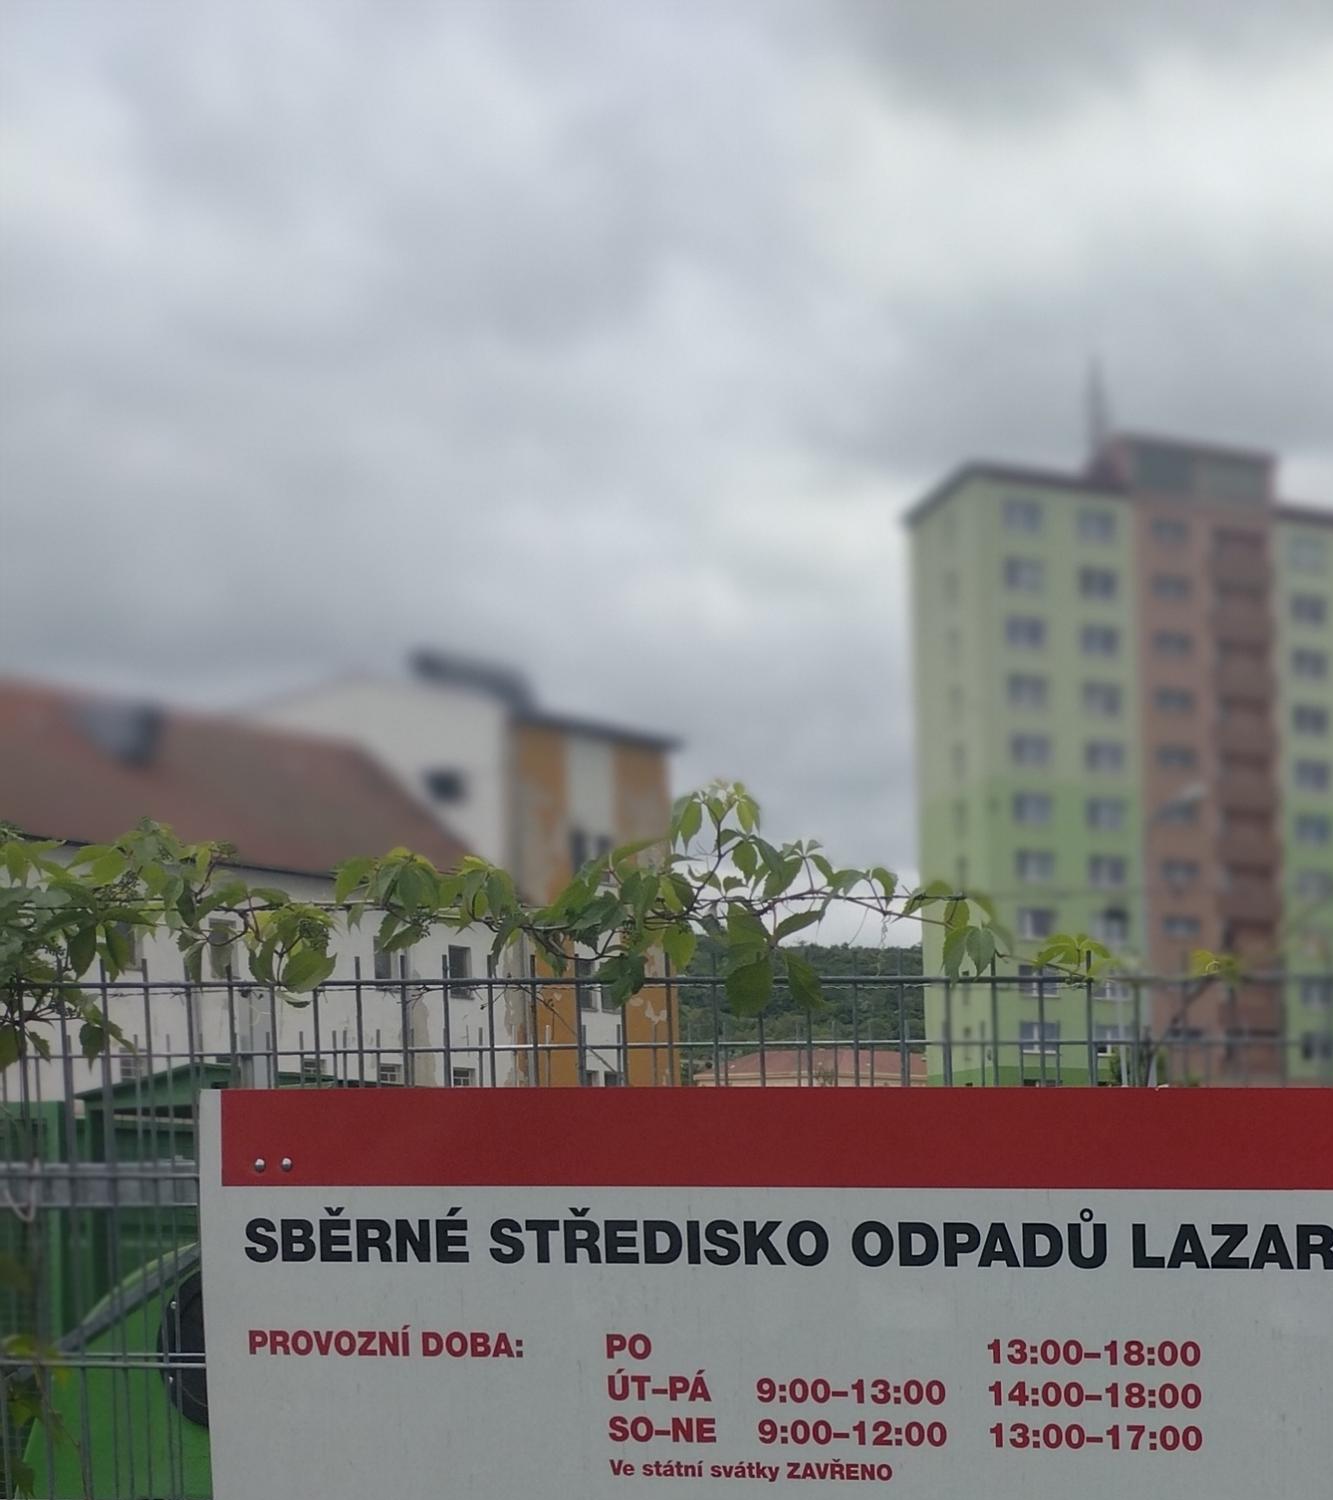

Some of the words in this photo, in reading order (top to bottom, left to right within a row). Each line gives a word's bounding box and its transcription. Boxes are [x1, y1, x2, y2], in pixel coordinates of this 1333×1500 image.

[244, 1206, 470, 1263] SBĚRNÉ
[489, 1207, 830, 1267] STŘEDISKO
[851, 1207, 1108, 1270] ODPADŮ
[248, 1324, 411, 1357] PROVOZNÍ
[421, 1331, 524, 1359] DOBA:
[605, 1333, 652, 1361] PO
[608, 1458, 636, 1477] Ve
[642, 1459, 704, 1478] státní
[710, 1460, 780, 1483] svátky
[786, 1458, 893, 1482] ZAVŘENO
